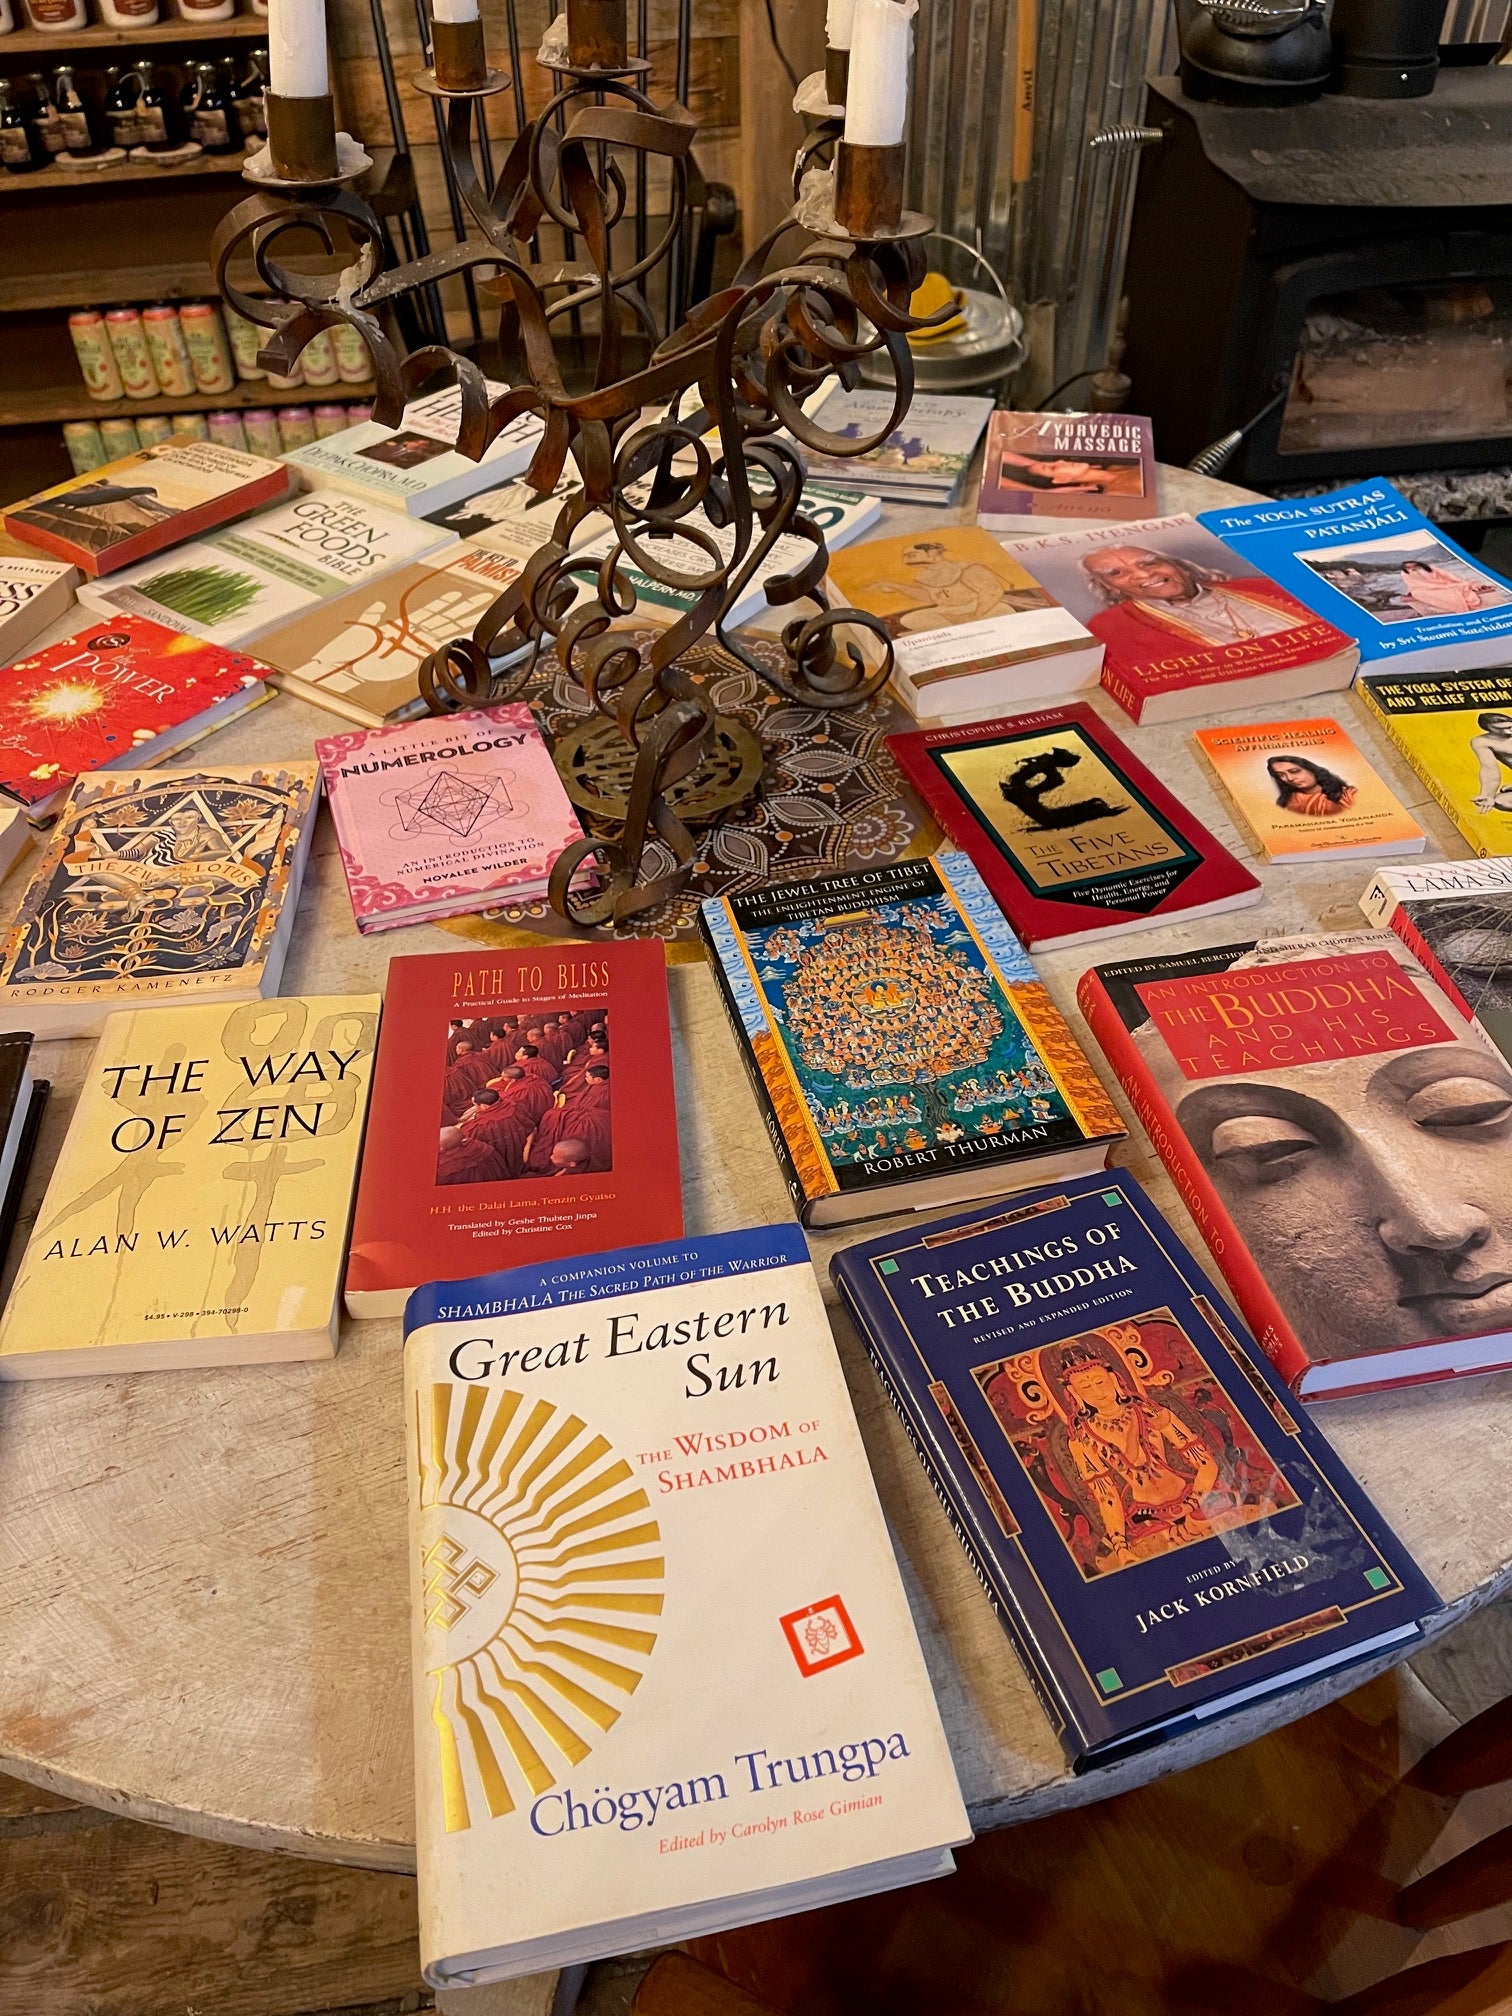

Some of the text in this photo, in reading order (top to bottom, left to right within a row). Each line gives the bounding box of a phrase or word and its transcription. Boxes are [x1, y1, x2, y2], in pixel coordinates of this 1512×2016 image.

[997, 420, 1141, 439] AYURVEDIC
[1054, 438, 1141, 453] MASSAGE
[294, 502, 390, 544] GREEN
[334, 501, 367, 517] THE
[1220, 490, 1386, 529] The YOGA SUTRAS
[1305, 510, 1408, 539] PATANJALI
[1364, 505, 1378, 516] of
[282, 521, 386, 567] FOODS
[1087, 515, 1192, 542] IYENGAR
[318, 554, 362, 577] BIBLE
[458, 554, 521, 585] PALMIST
[1132, 624, 1333, 678] LIGHT ON LIFE
[1379, 640, 1396, 650] by
[1417, 630, 1459, 642] Swami
[49, 651, 175, 703] POWER
[1375, 679, 1496, 696] THE YOGA SYSTEM
[1113, 678, 1136, 711] LIFE
[1386, 690, 1512, 708] AND RELIEF FROM
[383, 729, 495, 754] LITTLE BIT OF
[925, 712, 1064, 742] CHRISTOPHER KILHAM
[1211, 728, 1336, 746] SCIENTIFIC HEALING
[340, 733, 527, 778] NUMEROLOGY
[1236, 739, 1325, 752] AFFIRMATIONS
[396, 842, 545, 876] NUMERICAL DIVINATION
[402, 837, 535, 868] AN INTRODUCTION TO
[1024, 831, 1136, 856] THE FIVE
[1036, 841, 1169, 877] TIBETANS
[74, 861, 116, 876] THE
[194, 861, 252, 884] LOTUS
[422, 858, 528, 883] NOVALEE WILDER
[733, 863, 929, 908] THE JEWEL TREE OF TIBET
[1072, 870, 1178, 898] Five Dynamic Exercises for
[1407, 874, 1483, 893] LAMA
[751, 879, 927, 918] THE ENLIGHTENMENT ENGINE OF
[1091, 878, 1170, 902] Health, Energy, and
[1105, 887, 1167, 906] Personal Power
[786, 894, 900, 921] TIBETAN BUDDHISM
[452, 961, 609, 998] PATH TO BLISS
[1104, 966, 1143, 977] EDITED
[1158, 957, 1200, 971] SAMUEL
[1146, 957, 1389, 1000] AN INTRODUCTION TO
[10, 974, 234, 998] RODGER KAMENETZ
[463, 998, 494, 1007] Practical
[532, 995, 556, 1003] Stages
[569, 991, 608, 999] Meditation
[1161, 974, 1415, 1030] THE BUDDHA
[1209, 1008, 1391, 1049] AND HIS
[1181, 1021, 1437, 1075] TEACHINGS
[101, 1050, 361, 1099] THE WAY
[111, 1103, 324, 1153] OF ZEN
[864, 1125, 1048, 1175] ROBERT THURMAN
[1141, 1100, 1210, 1225] INTRODUCTION
[479, 1192, 616, 1211] Dalai Tenzin Gyatso
[448, 1212, 597, 1231] Translated Geshe Thubten Jinpa
[472, 1225, 553, 1239] Edited Christine
[42, 1220, 327, 1261] ALAN W. WATTS
[551, 1251, 699, 1286] COMPANION VOLUME TO
[910, 1222, 1121, 1299] TEACHINGS OF
[438, 1253, 788, 1320] SHAMBHALA THE SACRED PATH OF THE WARRIOR
[937, 1254, 1138, 1329] THE BUDDHA
[973, 1288, 1134, 1344] REVISED AND EXPANDED EDITION
[448, 1300, 791, 1381] Great Eastern
[685, 1351, 780, 1400] Sun
[637, 1420, 821, 1467] THE WISDOM OF
[658, 1444, 829, 1494] SHAMBHALA
[1186, 1565, 1221, 1584] EDITED
[1135, 1555, 1310, 1633] JACK KORNFIELD
[529, 1732, 911, 1838] Chögyam Trungpa
[658, 1793, 883, 1855] Edited by Carolyn Rose Gimian
